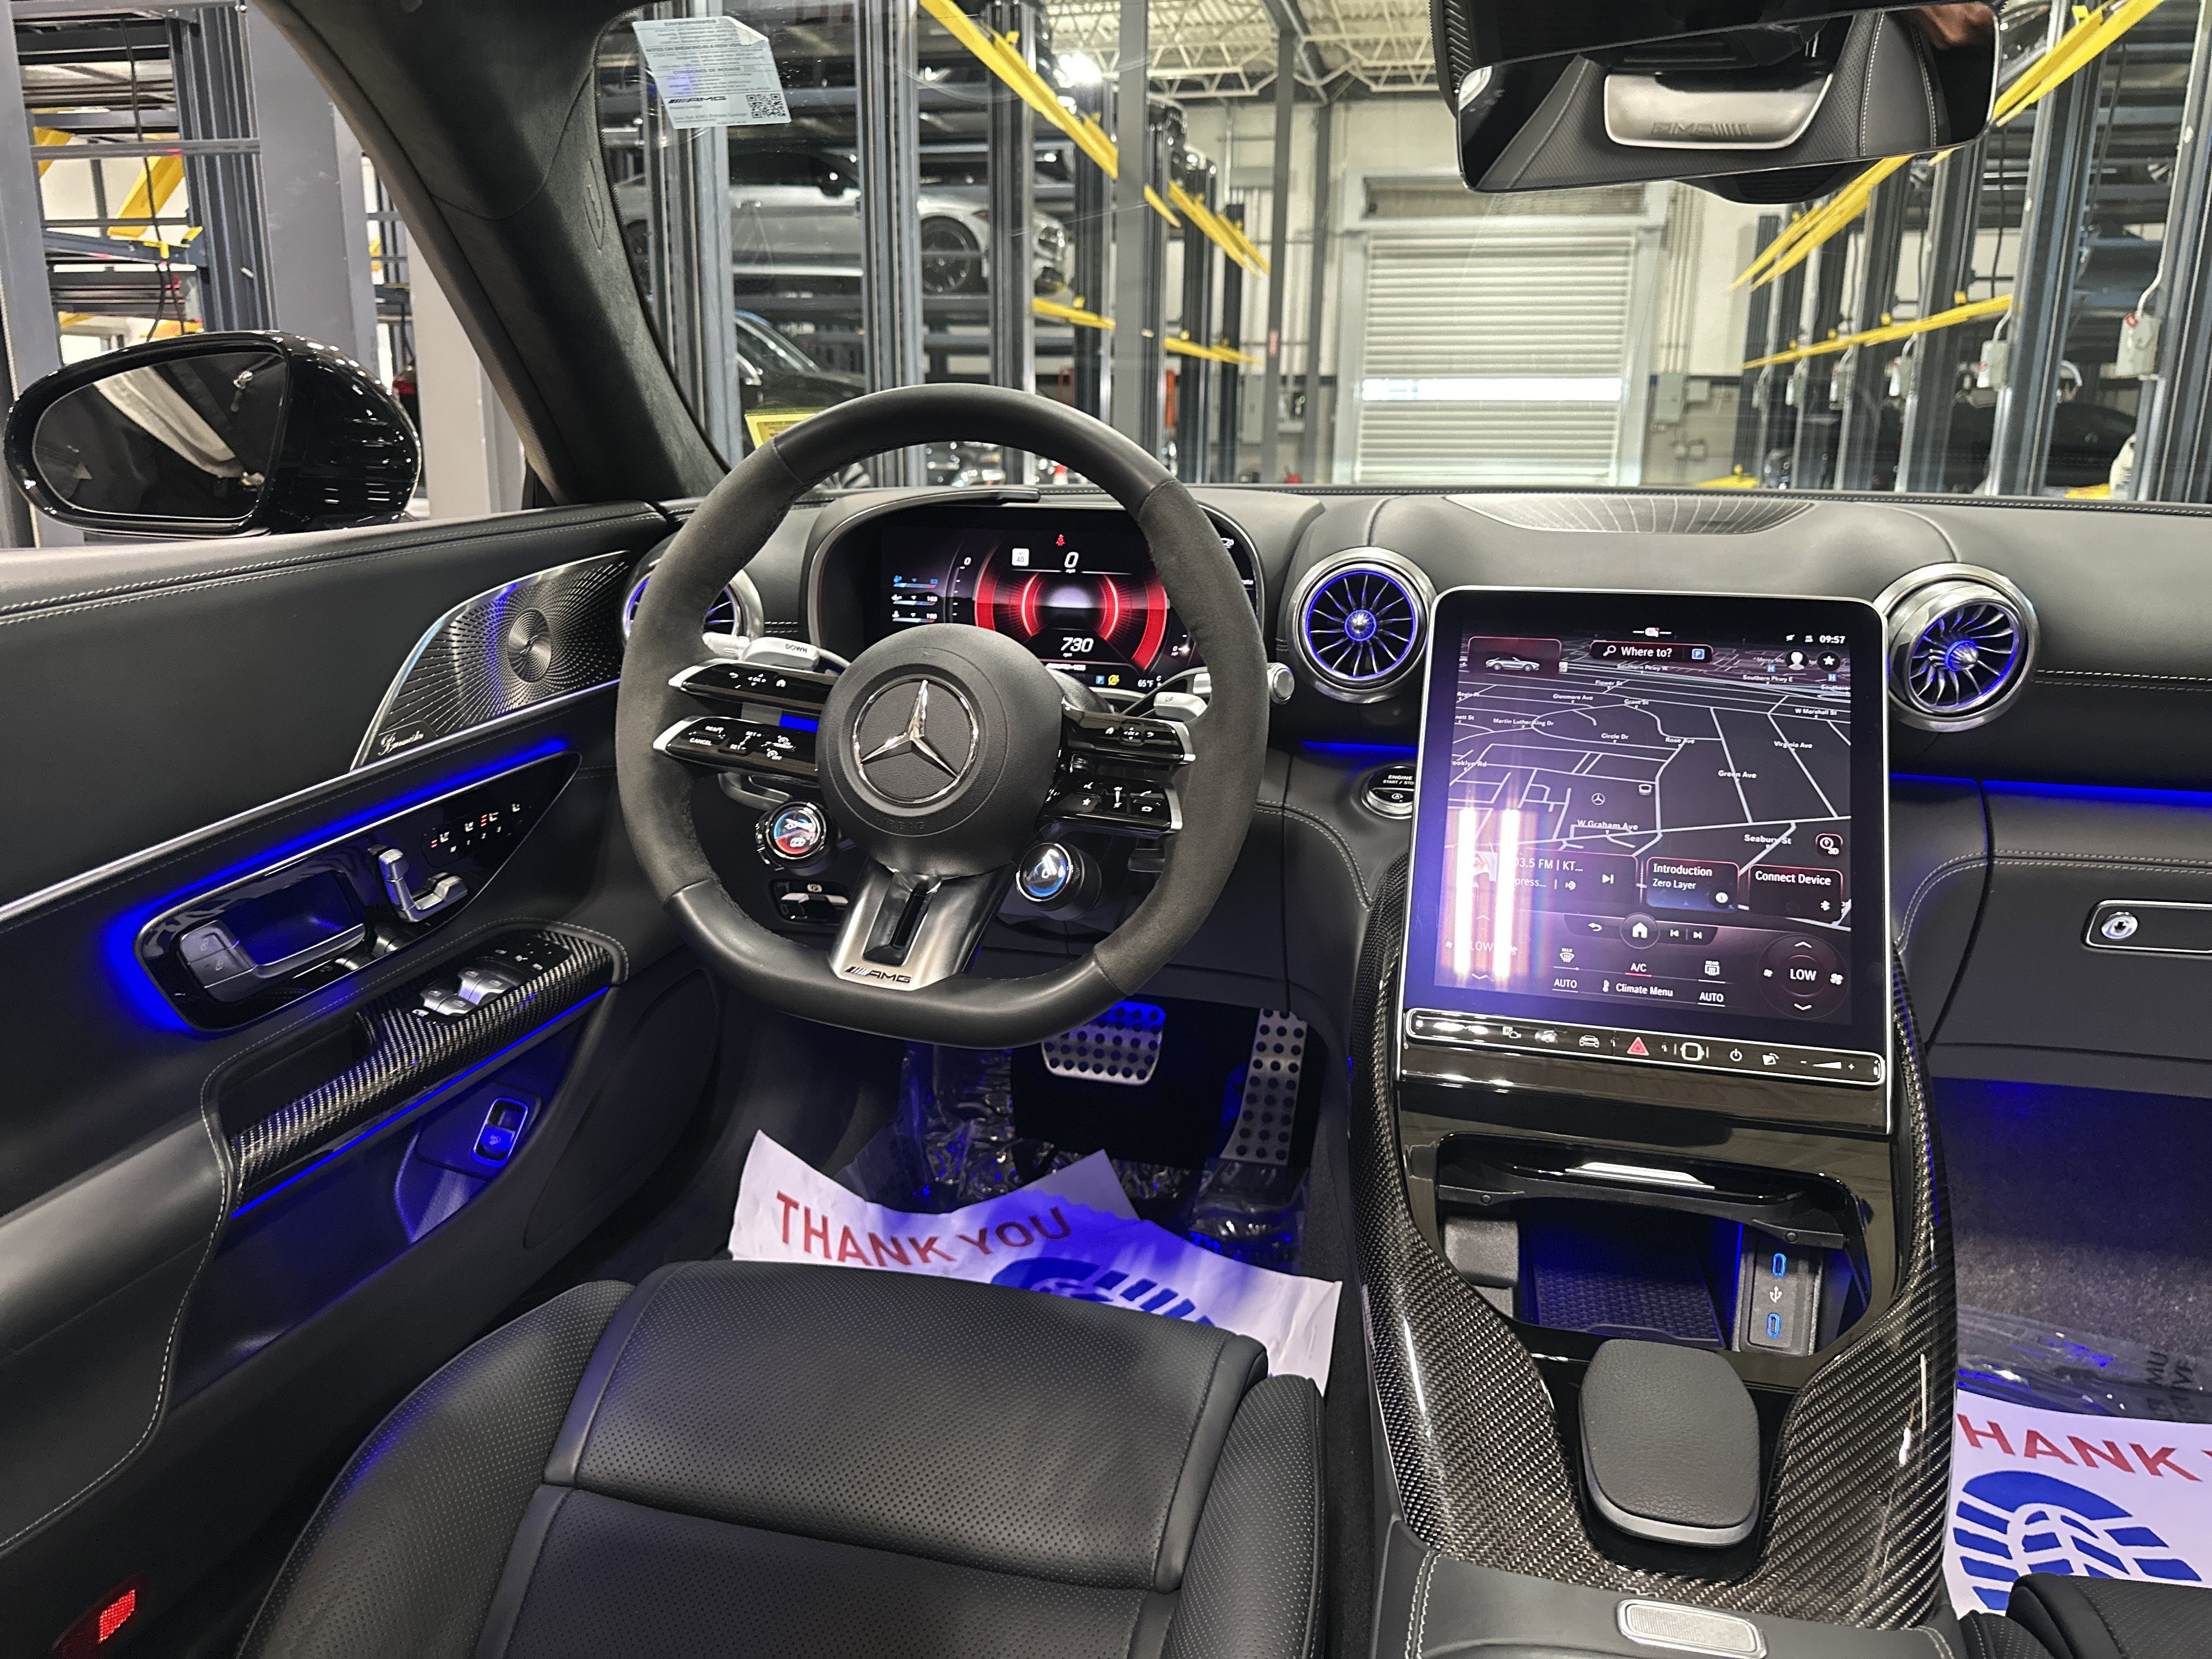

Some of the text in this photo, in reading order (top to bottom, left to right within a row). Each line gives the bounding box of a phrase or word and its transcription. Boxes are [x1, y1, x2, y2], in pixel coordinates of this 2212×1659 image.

[1064, 551, 1079, 568] 0
[1060, 637, 1094, 652] 730
[1819, 635, 1846, 644] 09:57
[785, 643, 808, 653] DOWN
[1621, 646, 1672, 657] Where to?
[1137, 679, 1154, 687] 65°F
[1718, 770, 1741, 778] Green
[1744, 834, 1779, 844] Seabury
[1538, 859, 1553, 869] FM
[1653, 863, 1713, 878] Introduction
[1755, 870, 1831, 886] Connect Device
[1652, 878, 1696, 891] Zero Layer
[1469, 941, 1493, 952] LOW
[1630, 962, 1647, 973] A/C
[864, 969, 911, 984] AMG
[1790, 969, 1816, 981] LOW
[1554, 978, 1577, 989] AUTO
[1616, 983, 1673, 997] Climate Menu
[1700, 992, 1724, 1002] AUTO
[775, 1190, 1072, 1267] THANK YOU
[1957, 1413, 2203, 1481] HANK
